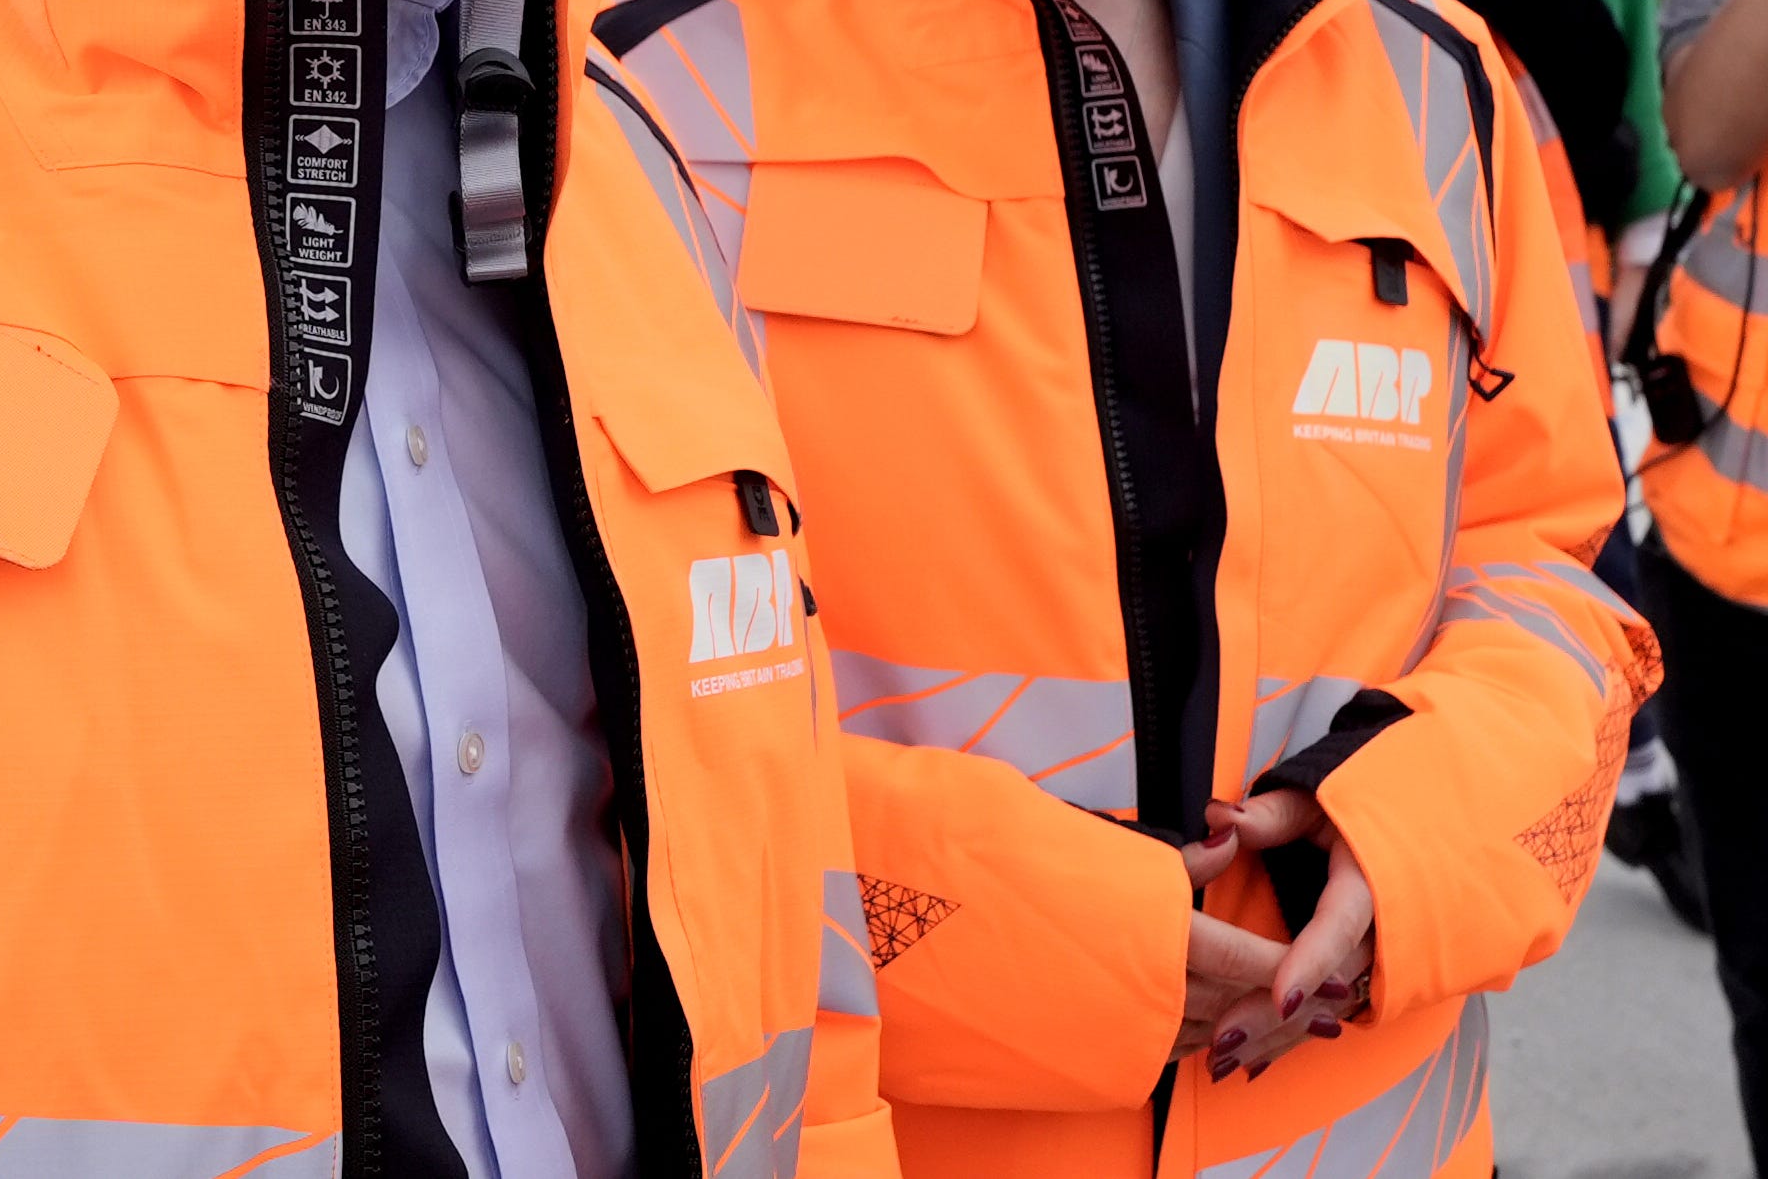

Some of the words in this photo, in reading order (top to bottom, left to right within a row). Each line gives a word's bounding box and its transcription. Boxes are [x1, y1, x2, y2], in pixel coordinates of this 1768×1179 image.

[304, 19, 324, 31] EN
[325, 19, 347, 32] 343
[304, 89, 324, 103] EN
[325, 90, 347, 104] 342
[297, 156, 348, 170] COMFORT
[297, 169, 347, 182] STRETCH
[302, 237, 335, 248] LIGHT
[298, 248, 343, 263] WEIGHT
[1292, 339, 1433, 425] ABP
[691, 672, 740, 698] KEEPING
